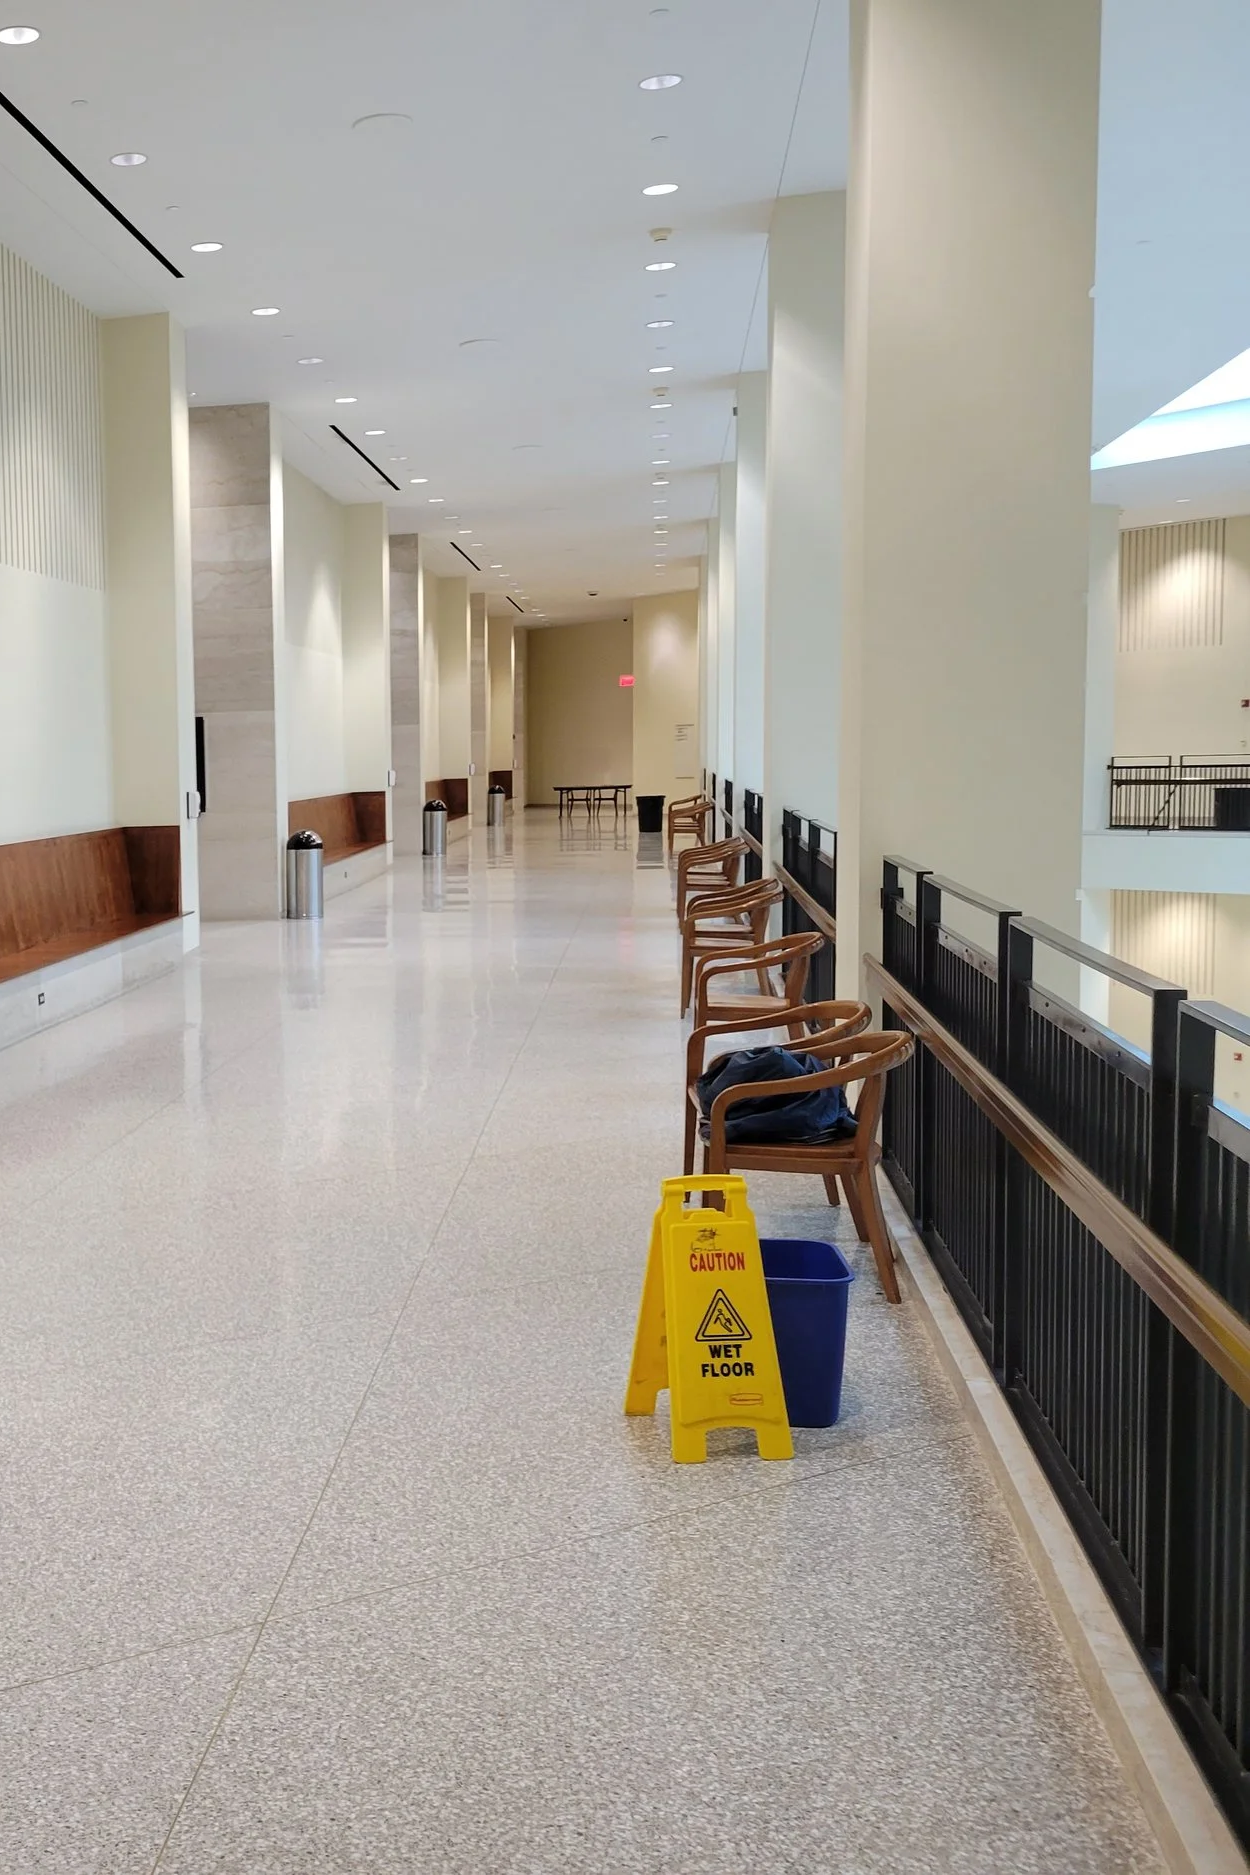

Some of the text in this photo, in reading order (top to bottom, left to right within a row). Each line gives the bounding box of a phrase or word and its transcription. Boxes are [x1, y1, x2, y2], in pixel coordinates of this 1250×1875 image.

[690, 1252, 745, 1272] CAUTION
[708, 1344, 742, 1358] WET
[701, 1362, 754, 1377] FLOOR
